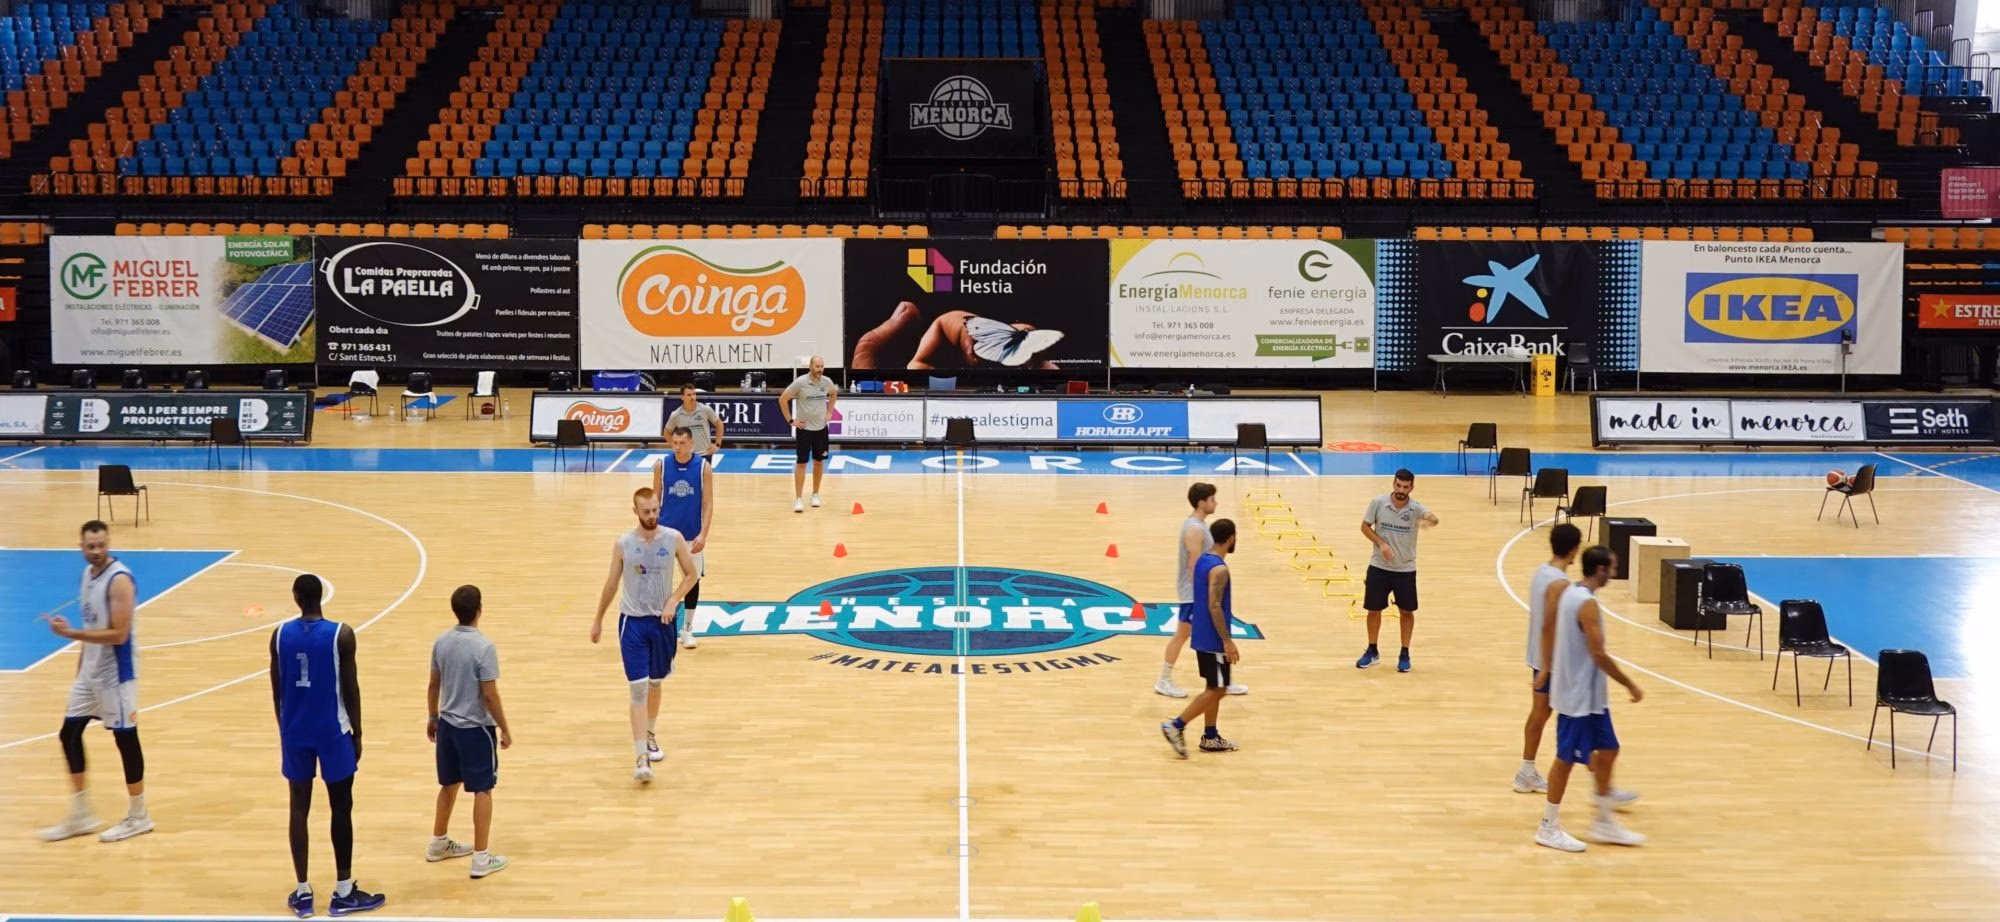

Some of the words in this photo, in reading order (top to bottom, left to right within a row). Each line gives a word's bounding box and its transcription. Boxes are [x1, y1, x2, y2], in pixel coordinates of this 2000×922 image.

[914, 106, 1009, 126] MENORCA
[228, 240, 261, 249] ENERGÍA
[1707, 245, 1757, 253] baloncesto
[1760, 245, 1781, 253] cada
[230, 249, 289, 258] FOTOVOLTÁICA
[112, 260, 198, 278] MIGUEL
[355, 266, 394, 276] Comidas
[960, 259, 1047, 275] Fundación
[114, 280, 200, 297] FEBRER
[344, 268, 374, 295] LA
[382, 279, 453, 298] PAELLA
[960, 279, 1013, 294] Hestia
[1119, 284, 1247, 302] EnergíaMenorca
[1311, 286, 1367, 301] energía
[637, 273, 788, 332] Coinga
[1703, 294, 1843, 321] IKEA
[1955, 304, 2000, 318] ESTRE
[1270, 317, 1365, 327] www.fenieenergia.es
[91, 328, 170, 336] info@miguelfebrer.es
[1134, 332, 1231, 341] info@energiamenorca.es
[1442, 332, 1566, 356] CaixaBank
[80, 348, 182, 358] www.miguelfebrer.es
[329, 353, 337, 362] C/
[340, 353, 358, 361] Sant
[360, 354, 386, 362] Esteve,
[650, 344, 773, 364] NATURALMENT
[1130, 350, 1236, 359] www.energiamenorca.es
[890, 382, 899, 393] 5
[120, 406, 146, 415] ARA
[148, 406, 152, 415] I
[155, 406, 178, 415] PER
[181, 406, 228, 414] SEMPRE
[702, 402, 762, 424] ERI
[848, 411, 914, 422] Fundación
[1110, 406, 1136, 421] HR
[1610, 403, 1681, 432] made
[1691, 407, 1721, 430] in
[1922, 408, 1968, 427] Seth
[123, 416, 186, 425] PRODUCTE
[189, 416, 224, 425] LOC
[571, 410, 624, 432] Coinga
[1741, 411, 1853, 433] menorca
[848, 425, 888, 436] Hestia
[1075, 426, 1172, 437] HORMIRAPIT
[841, 597, 1077, 606] HESTIA
[296, 653, 311, 688] 1
[808, 652, 1122, 676] #MATEALESTIGMA
